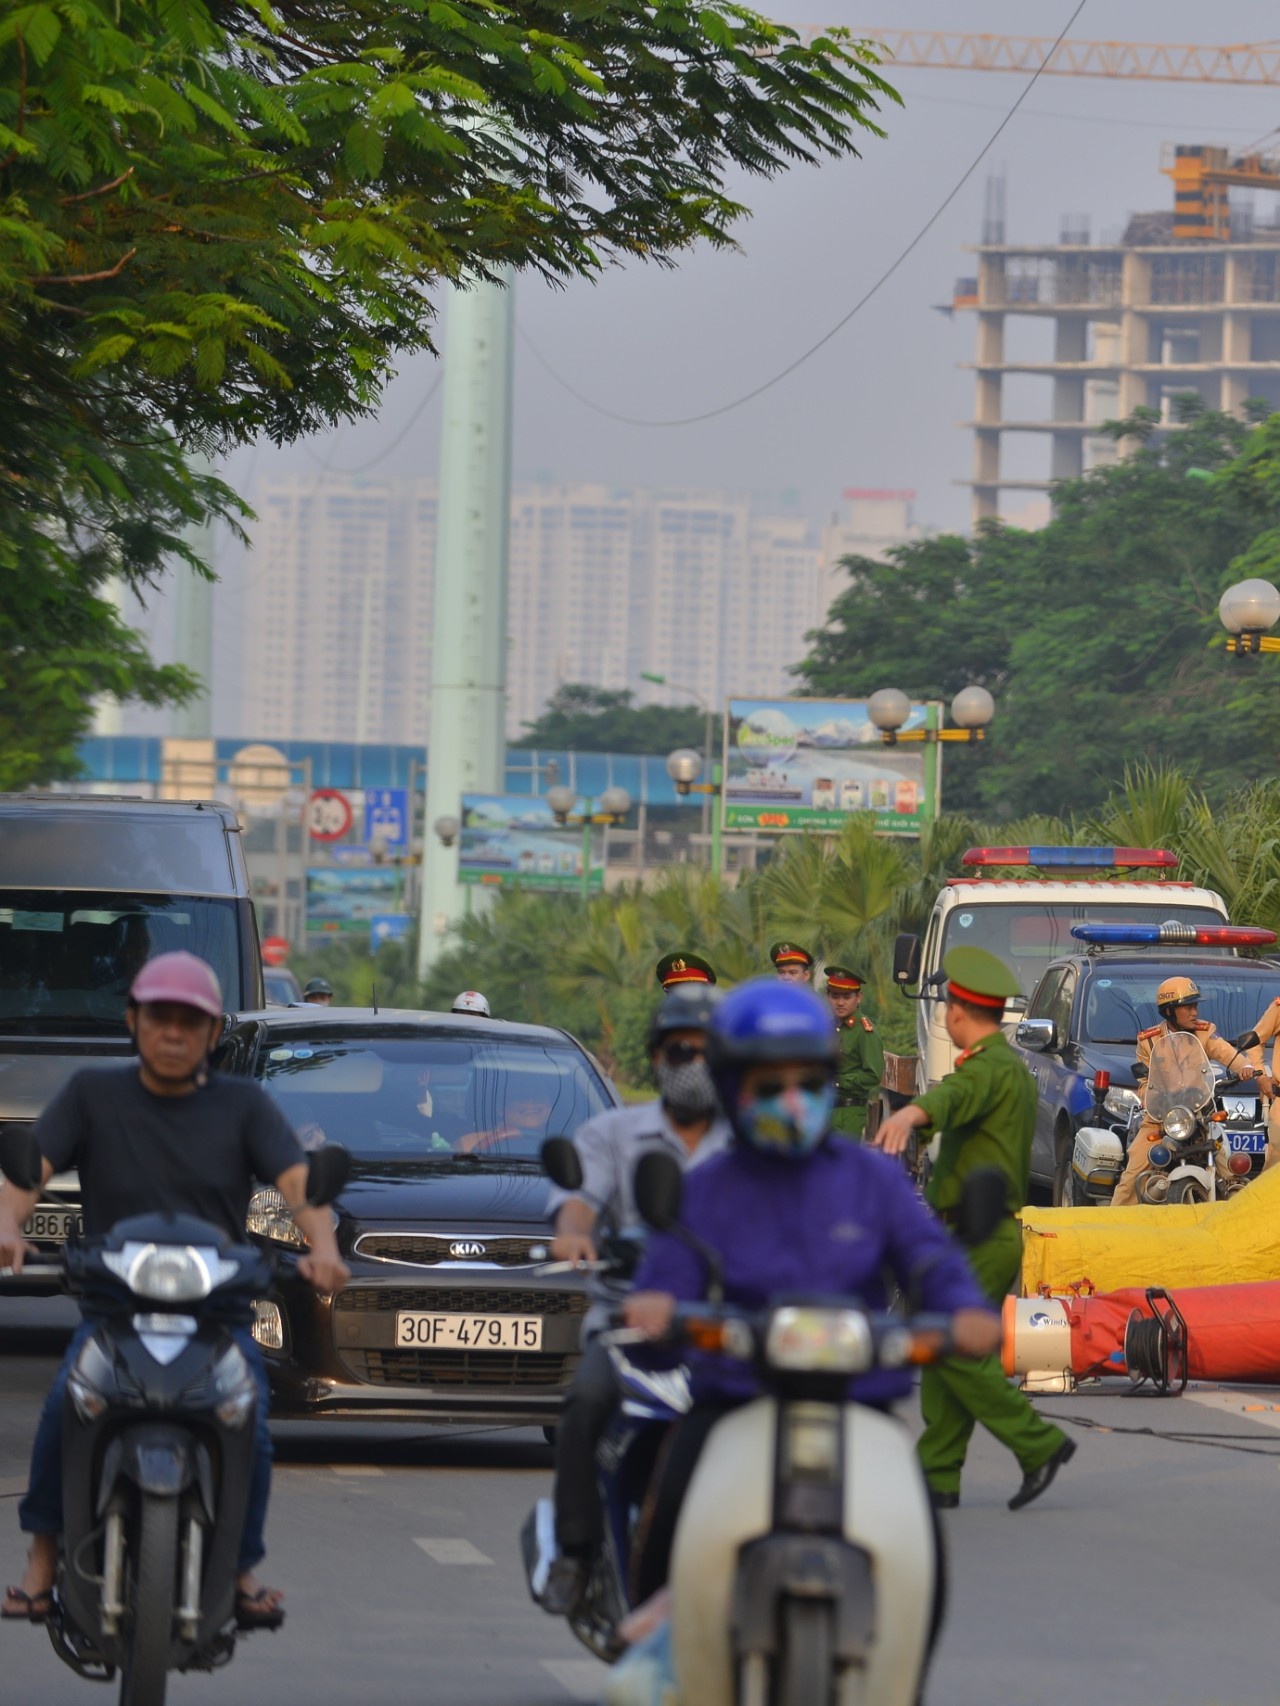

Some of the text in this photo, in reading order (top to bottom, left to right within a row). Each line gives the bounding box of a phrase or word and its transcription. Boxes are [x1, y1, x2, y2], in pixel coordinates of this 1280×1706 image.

[455, 1245, 480, 1255] KIA
[1043, 1318, 1067, 1327] Windy
[401, 1317, 538, 1346] 30F-479.15
